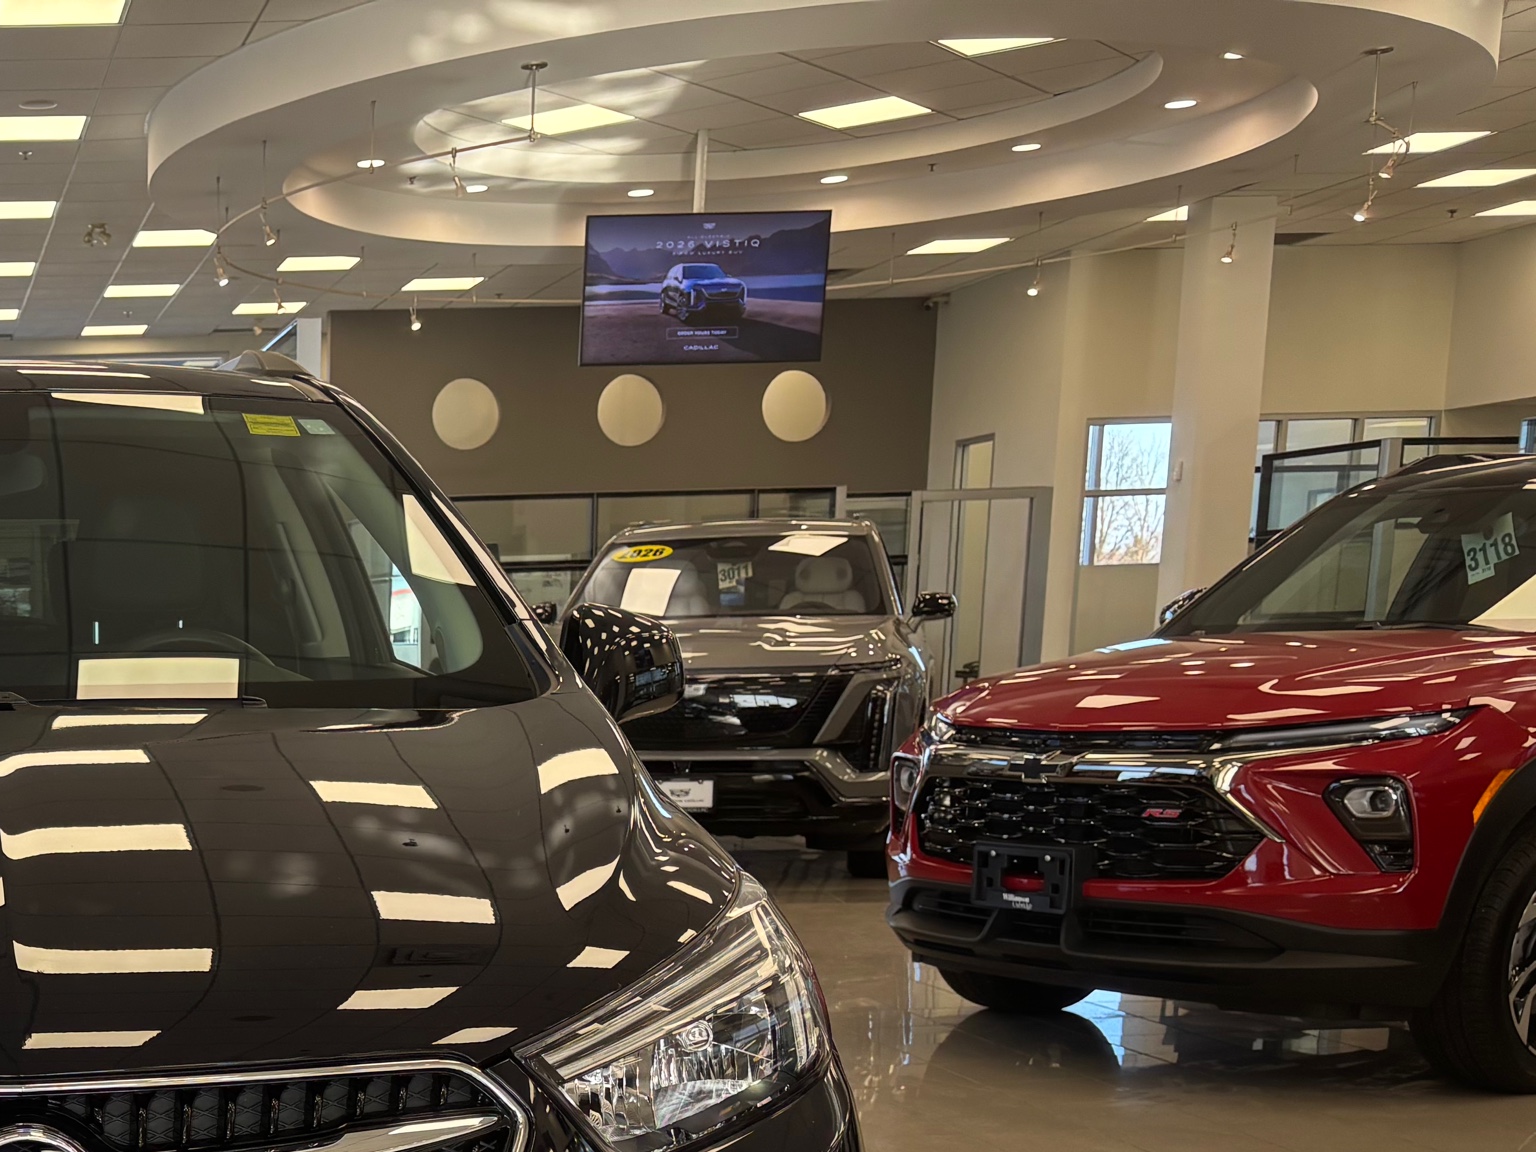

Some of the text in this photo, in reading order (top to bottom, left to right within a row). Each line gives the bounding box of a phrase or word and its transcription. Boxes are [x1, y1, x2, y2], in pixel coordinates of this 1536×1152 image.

[655, 239, 760, 249] 2026 VISTIQ
[1466, 532, 1516, 572] 3118
[719, 564, 752, 582] 3011
[1141, 808, 1182, 818] RS
